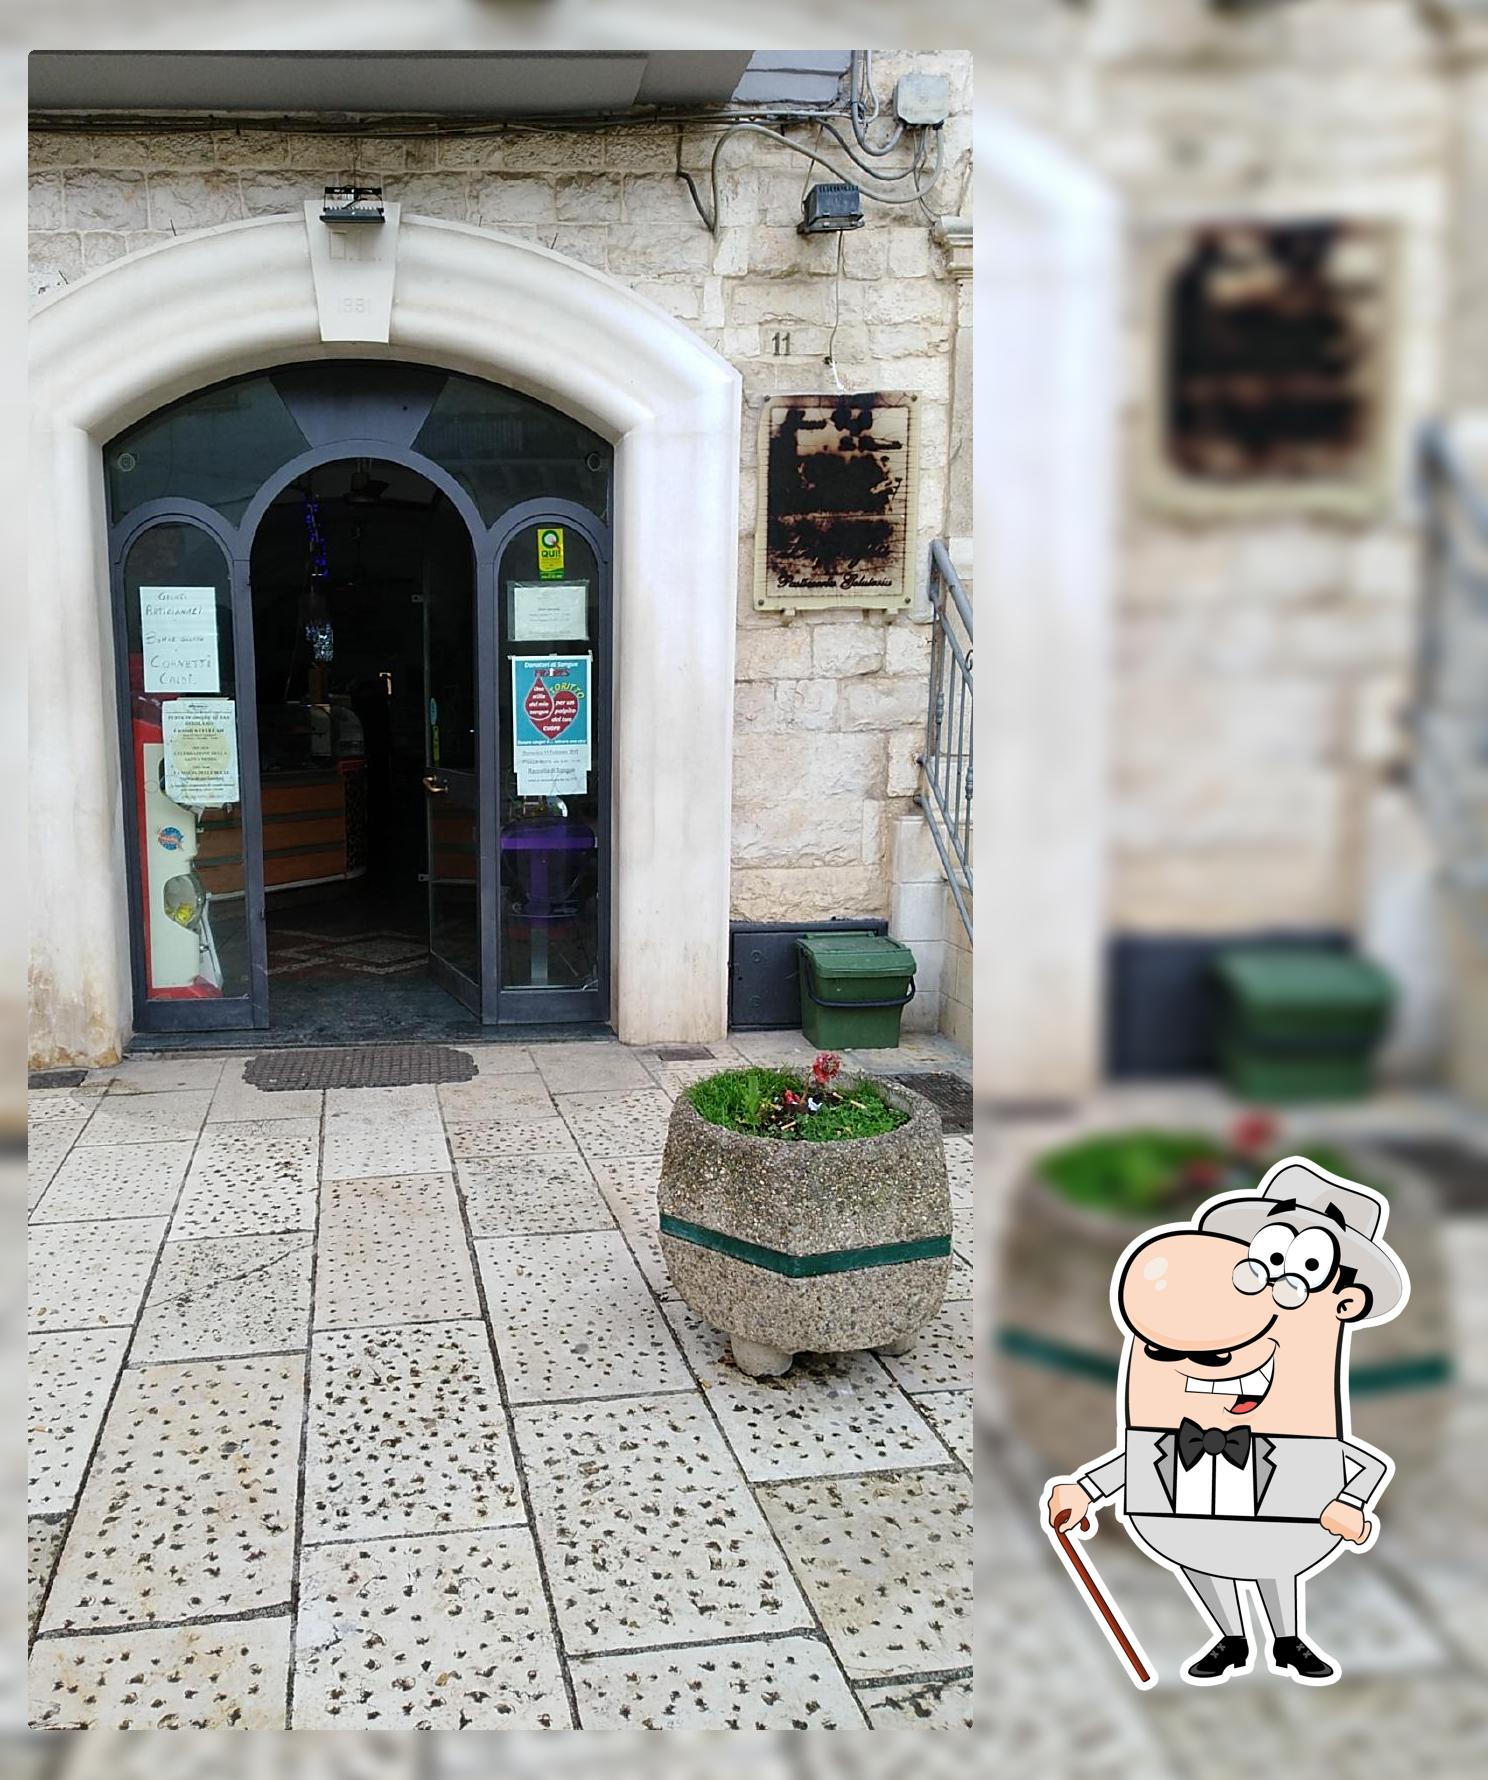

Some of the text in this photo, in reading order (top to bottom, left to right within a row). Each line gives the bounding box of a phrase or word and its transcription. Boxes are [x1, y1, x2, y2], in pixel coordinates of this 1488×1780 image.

[772, 332, 791, 356] 11
[558, 661, 579, 669] Sangue
[550, 682, 585, 699] TORITTO
[554, 707, 577, 715] palpito
